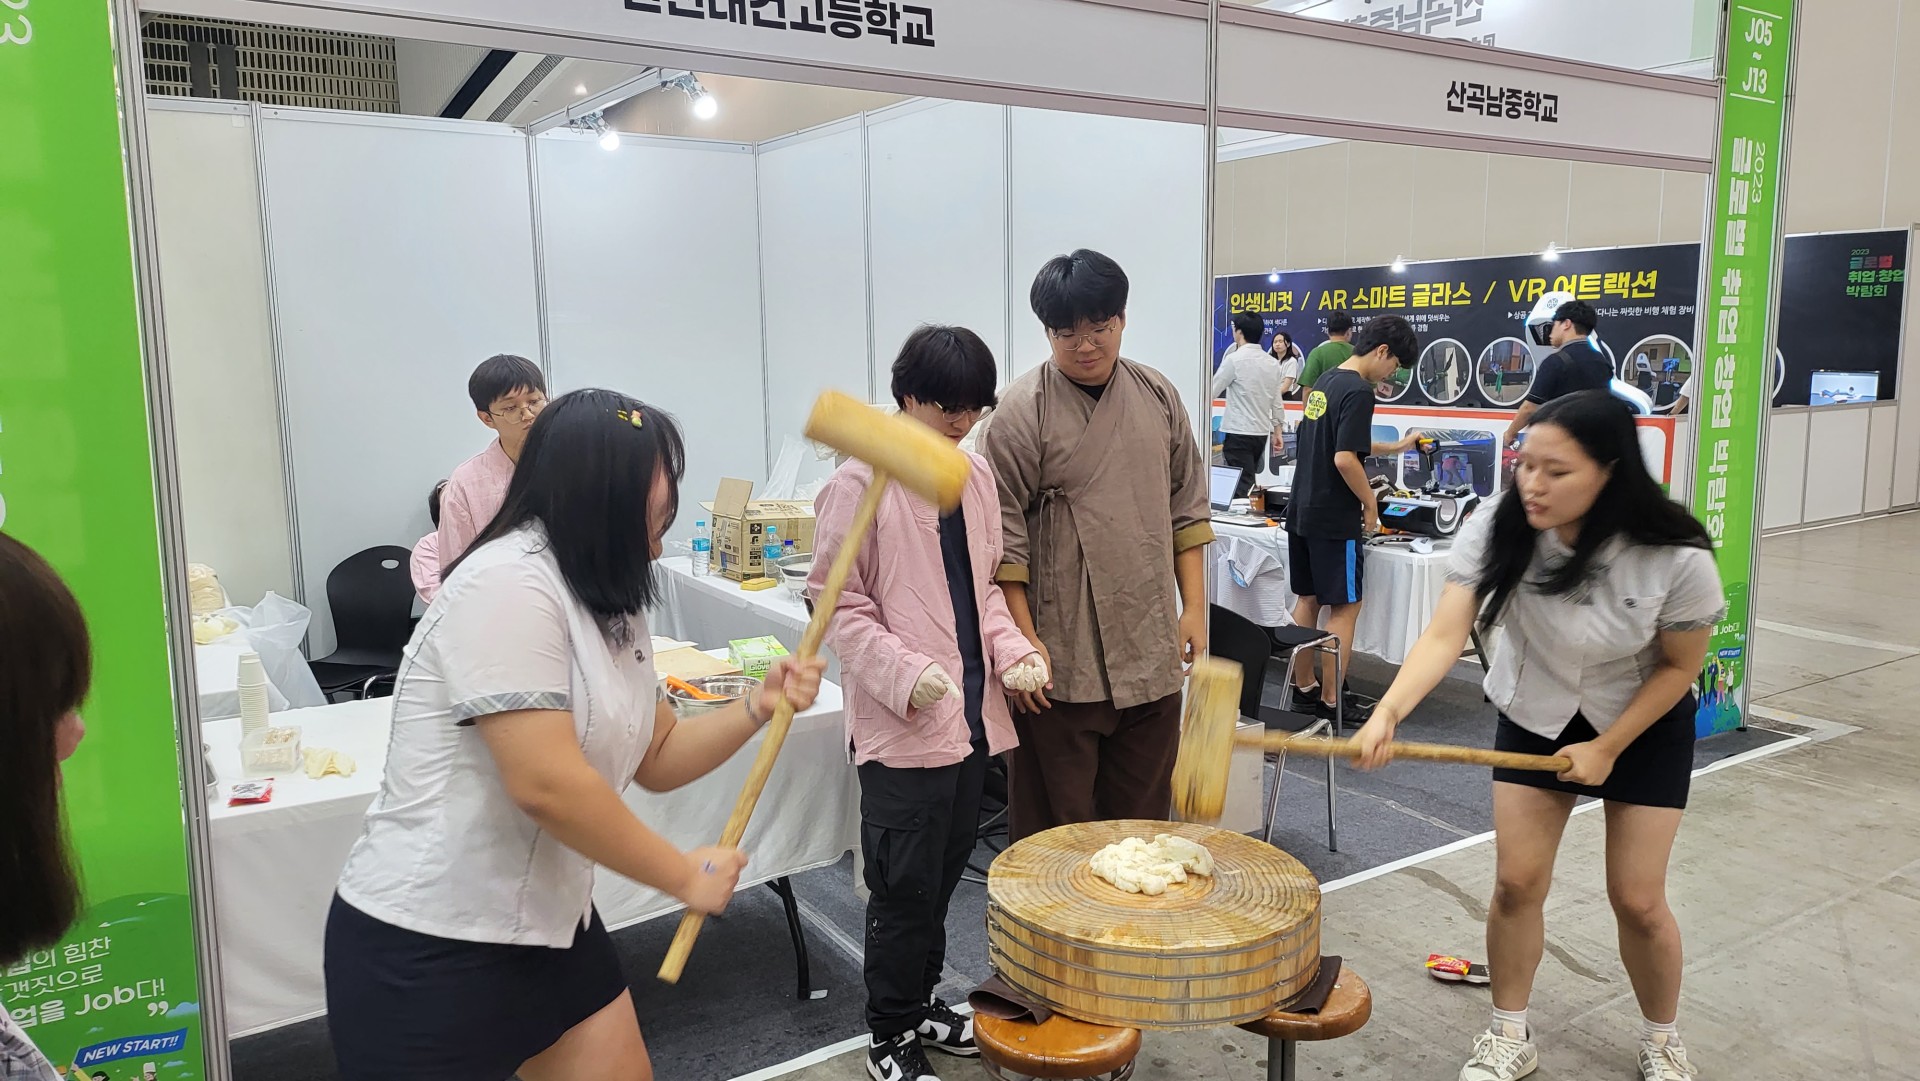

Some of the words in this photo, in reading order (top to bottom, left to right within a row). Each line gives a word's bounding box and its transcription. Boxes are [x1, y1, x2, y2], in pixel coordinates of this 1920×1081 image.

[1744, 18, 1773, 47] J05
[1742, 67, 1768, 94] J13
[1446, 80, 1558, 123] 산곡남중학교
[1751, 142, 1766, 204] 2023
[1725, 136, 1753, 256] 글로벌
[1851, 248, 1870, 256] 2023
[1230, 290, 1293, 314] 인생네컷
[1318, 289, 1347, 310] AR
[1352, 284, 1406, 310] 스마트
[1412, 281, 1471, 307] 글라스
[1508, 278, 1547, 303] VR
[1552, 269, 1658, 300] 어트랙션
[1846, 284, 1887, 298] 박람회
[1620, 306, 1643, 316] 짜릿한
[1644, 306, 1660, 316] 비행
[1661, 305, 1677, 316] 체험
[1679, 305, 1695, 315] 장비
[1706, 439, 1729, 548] 박람회
[63, 936, 111, 964] 힘찬
[0, 964, 103, 1002] 갯짓으로
[75, 978, 166, 1016] Job다!
[83, 1043, 121, 1063] NEW
[122, 1035, 179, 1053] START!!
